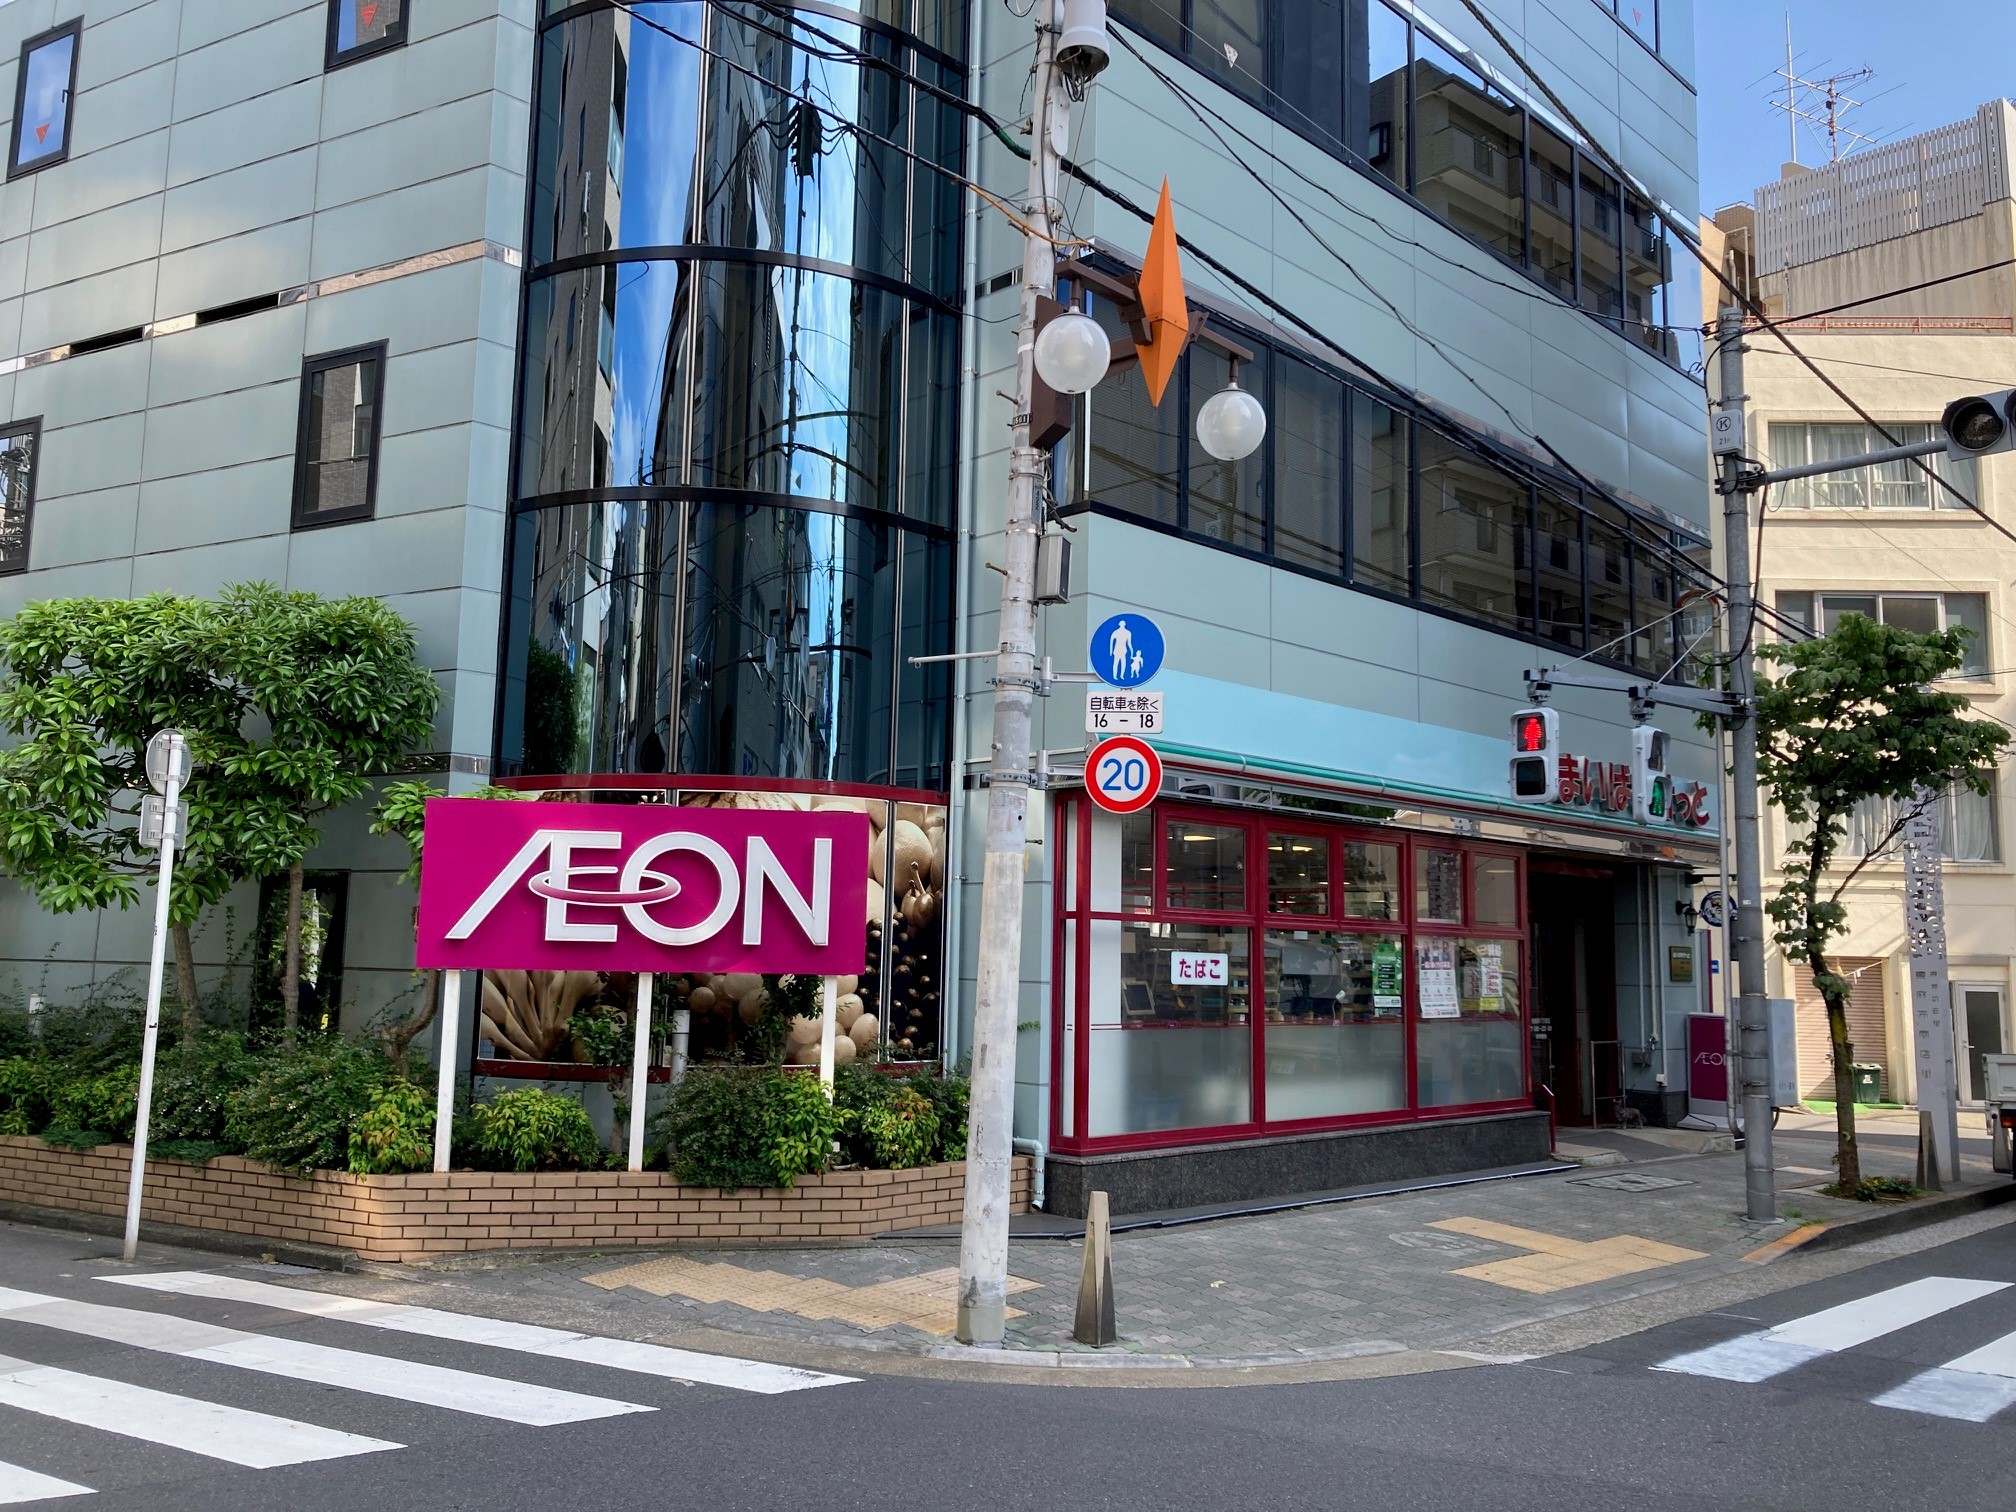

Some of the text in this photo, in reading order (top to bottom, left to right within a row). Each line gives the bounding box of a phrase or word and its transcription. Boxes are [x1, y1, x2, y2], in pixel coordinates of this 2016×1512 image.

[1090, 696, 1159, 711] 自転車を除く
[1094, 714, 1108, 728] 16
[1139, 714, 1154, 728] 18
[1102, 758, 1144, 791] 20
[1178, 957, 1221, 979] たばこ
